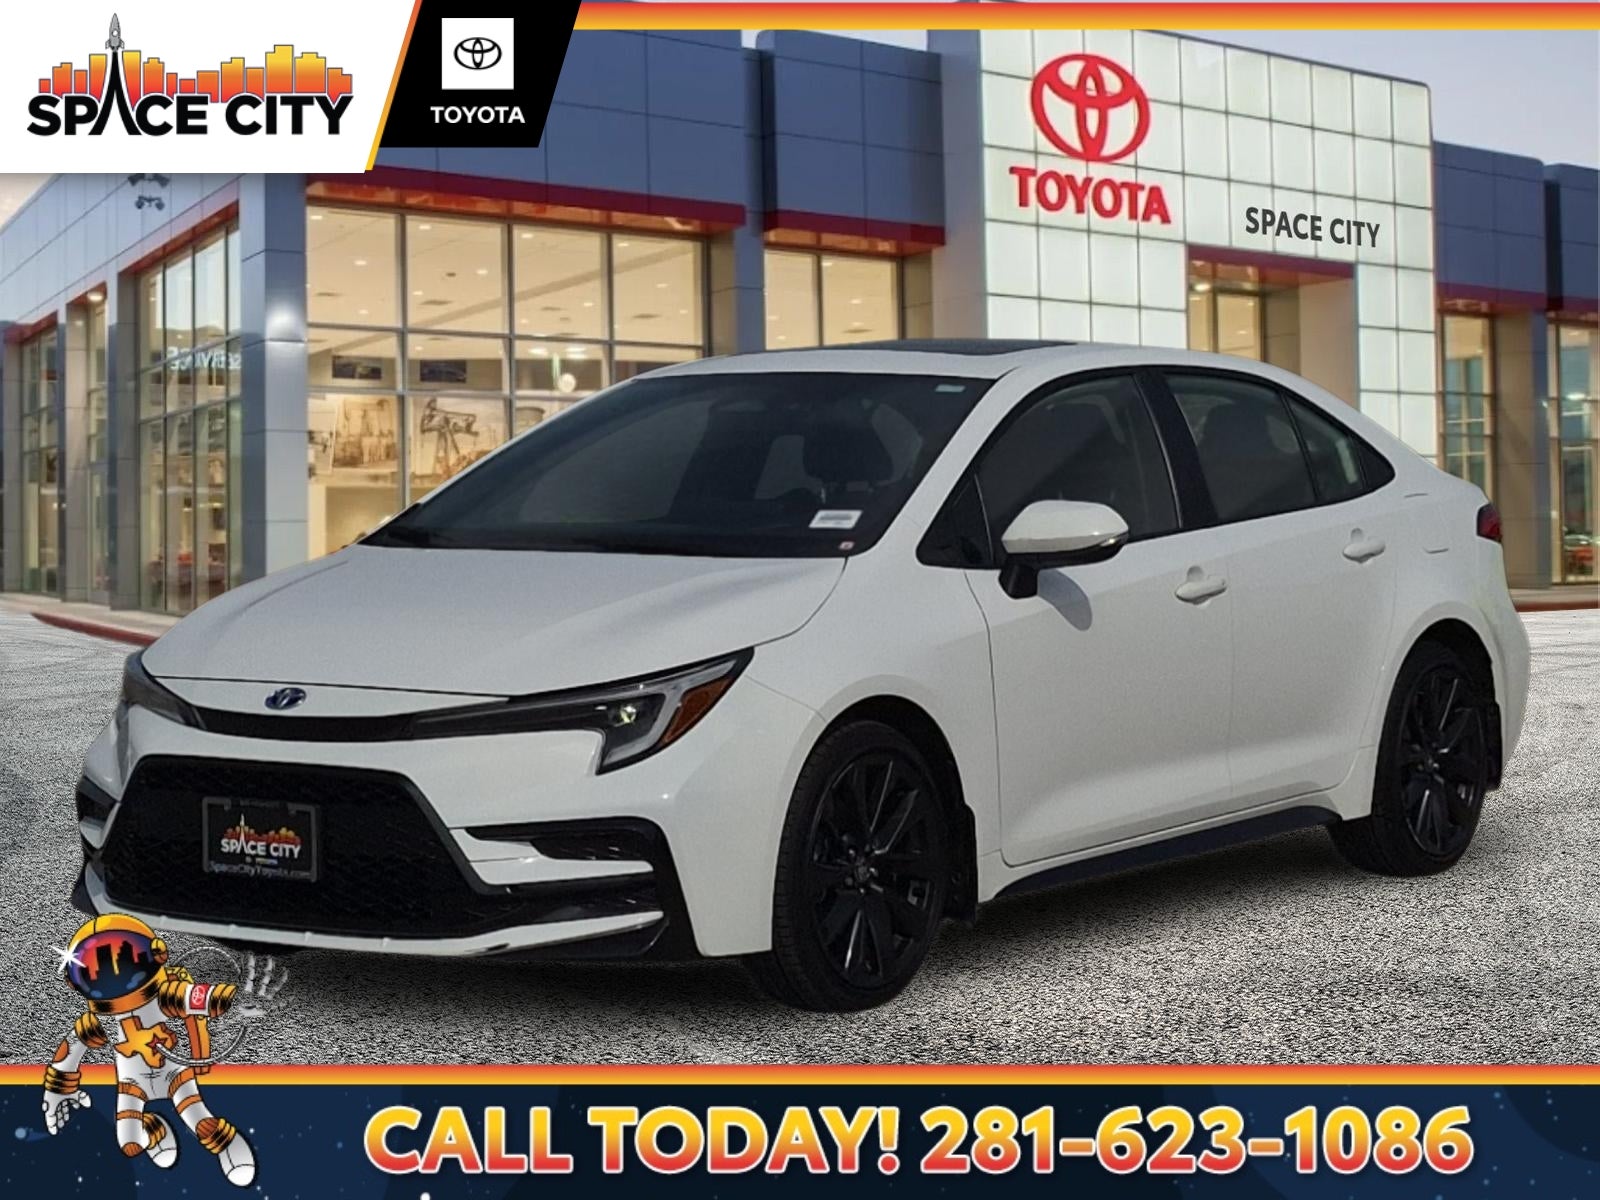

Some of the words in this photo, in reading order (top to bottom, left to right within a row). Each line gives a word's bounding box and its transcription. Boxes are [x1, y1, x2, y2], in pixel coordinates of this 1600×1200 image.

[1009, 166, 1171, 225] TOYOTA
[1245, 207, 1322, 241] SPACE
[1329, 218, 1380, 248] CITY
[220, 829, 266, 856] SPACE
[270, 843, 301, 859] CITY
